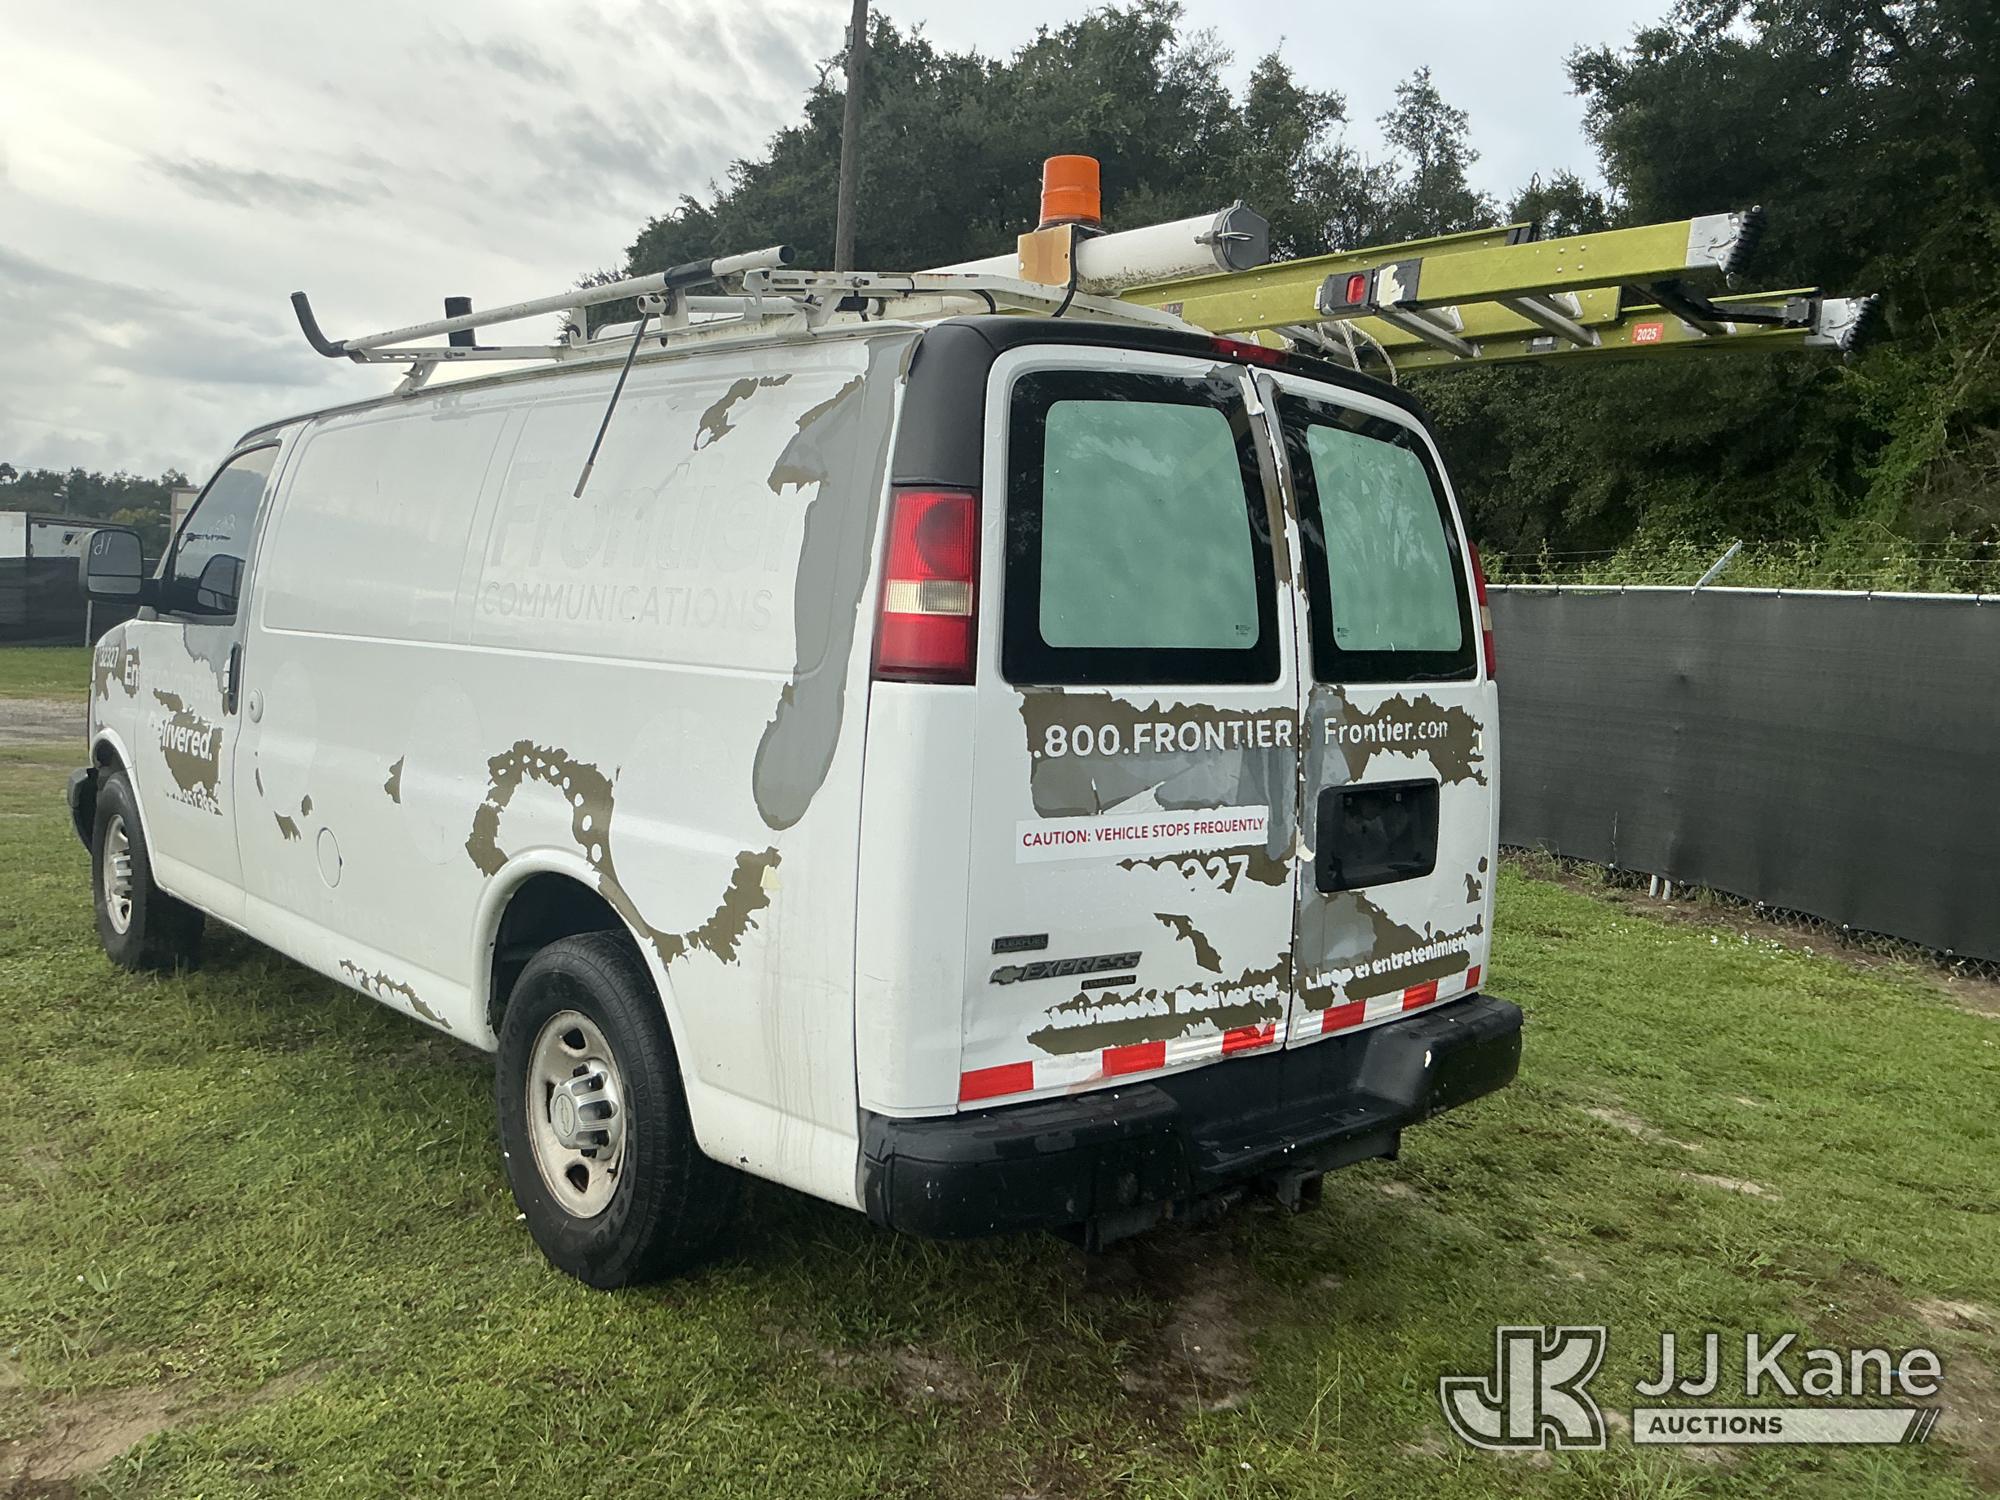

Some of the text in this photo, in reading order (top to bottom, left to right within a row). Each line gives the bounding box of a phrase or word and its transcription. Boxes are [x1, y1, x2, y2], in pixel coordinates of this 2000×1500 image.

[1636, 328, 1657, 342] 2025
[481, 581, 775, 631] COMMUNICATIONS
[1022, 817, 1265, 847] CAUTION: VEHICLE STOPS FREQUENTLY
[1022, 953, 1141, 980] EXPRESS
